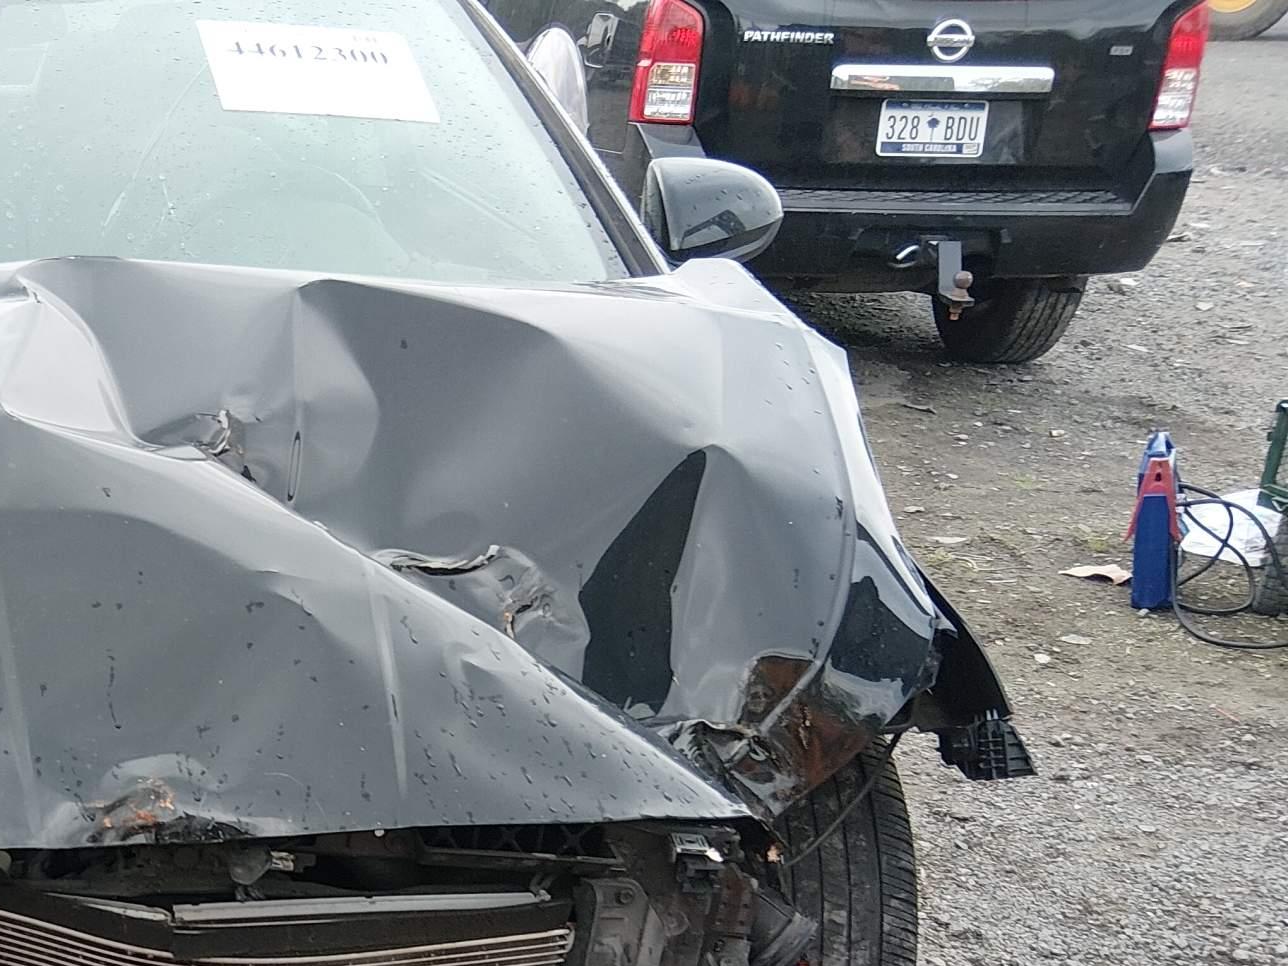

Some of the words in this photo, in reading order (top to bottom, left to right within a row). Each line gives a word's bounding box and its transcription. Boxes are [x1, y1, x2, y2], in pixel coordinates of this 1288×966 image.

[743, 31, 835, 44] PATHFINDER
[885, 115, 921, 140] 328
[944, 116, 981, 141] BDU
